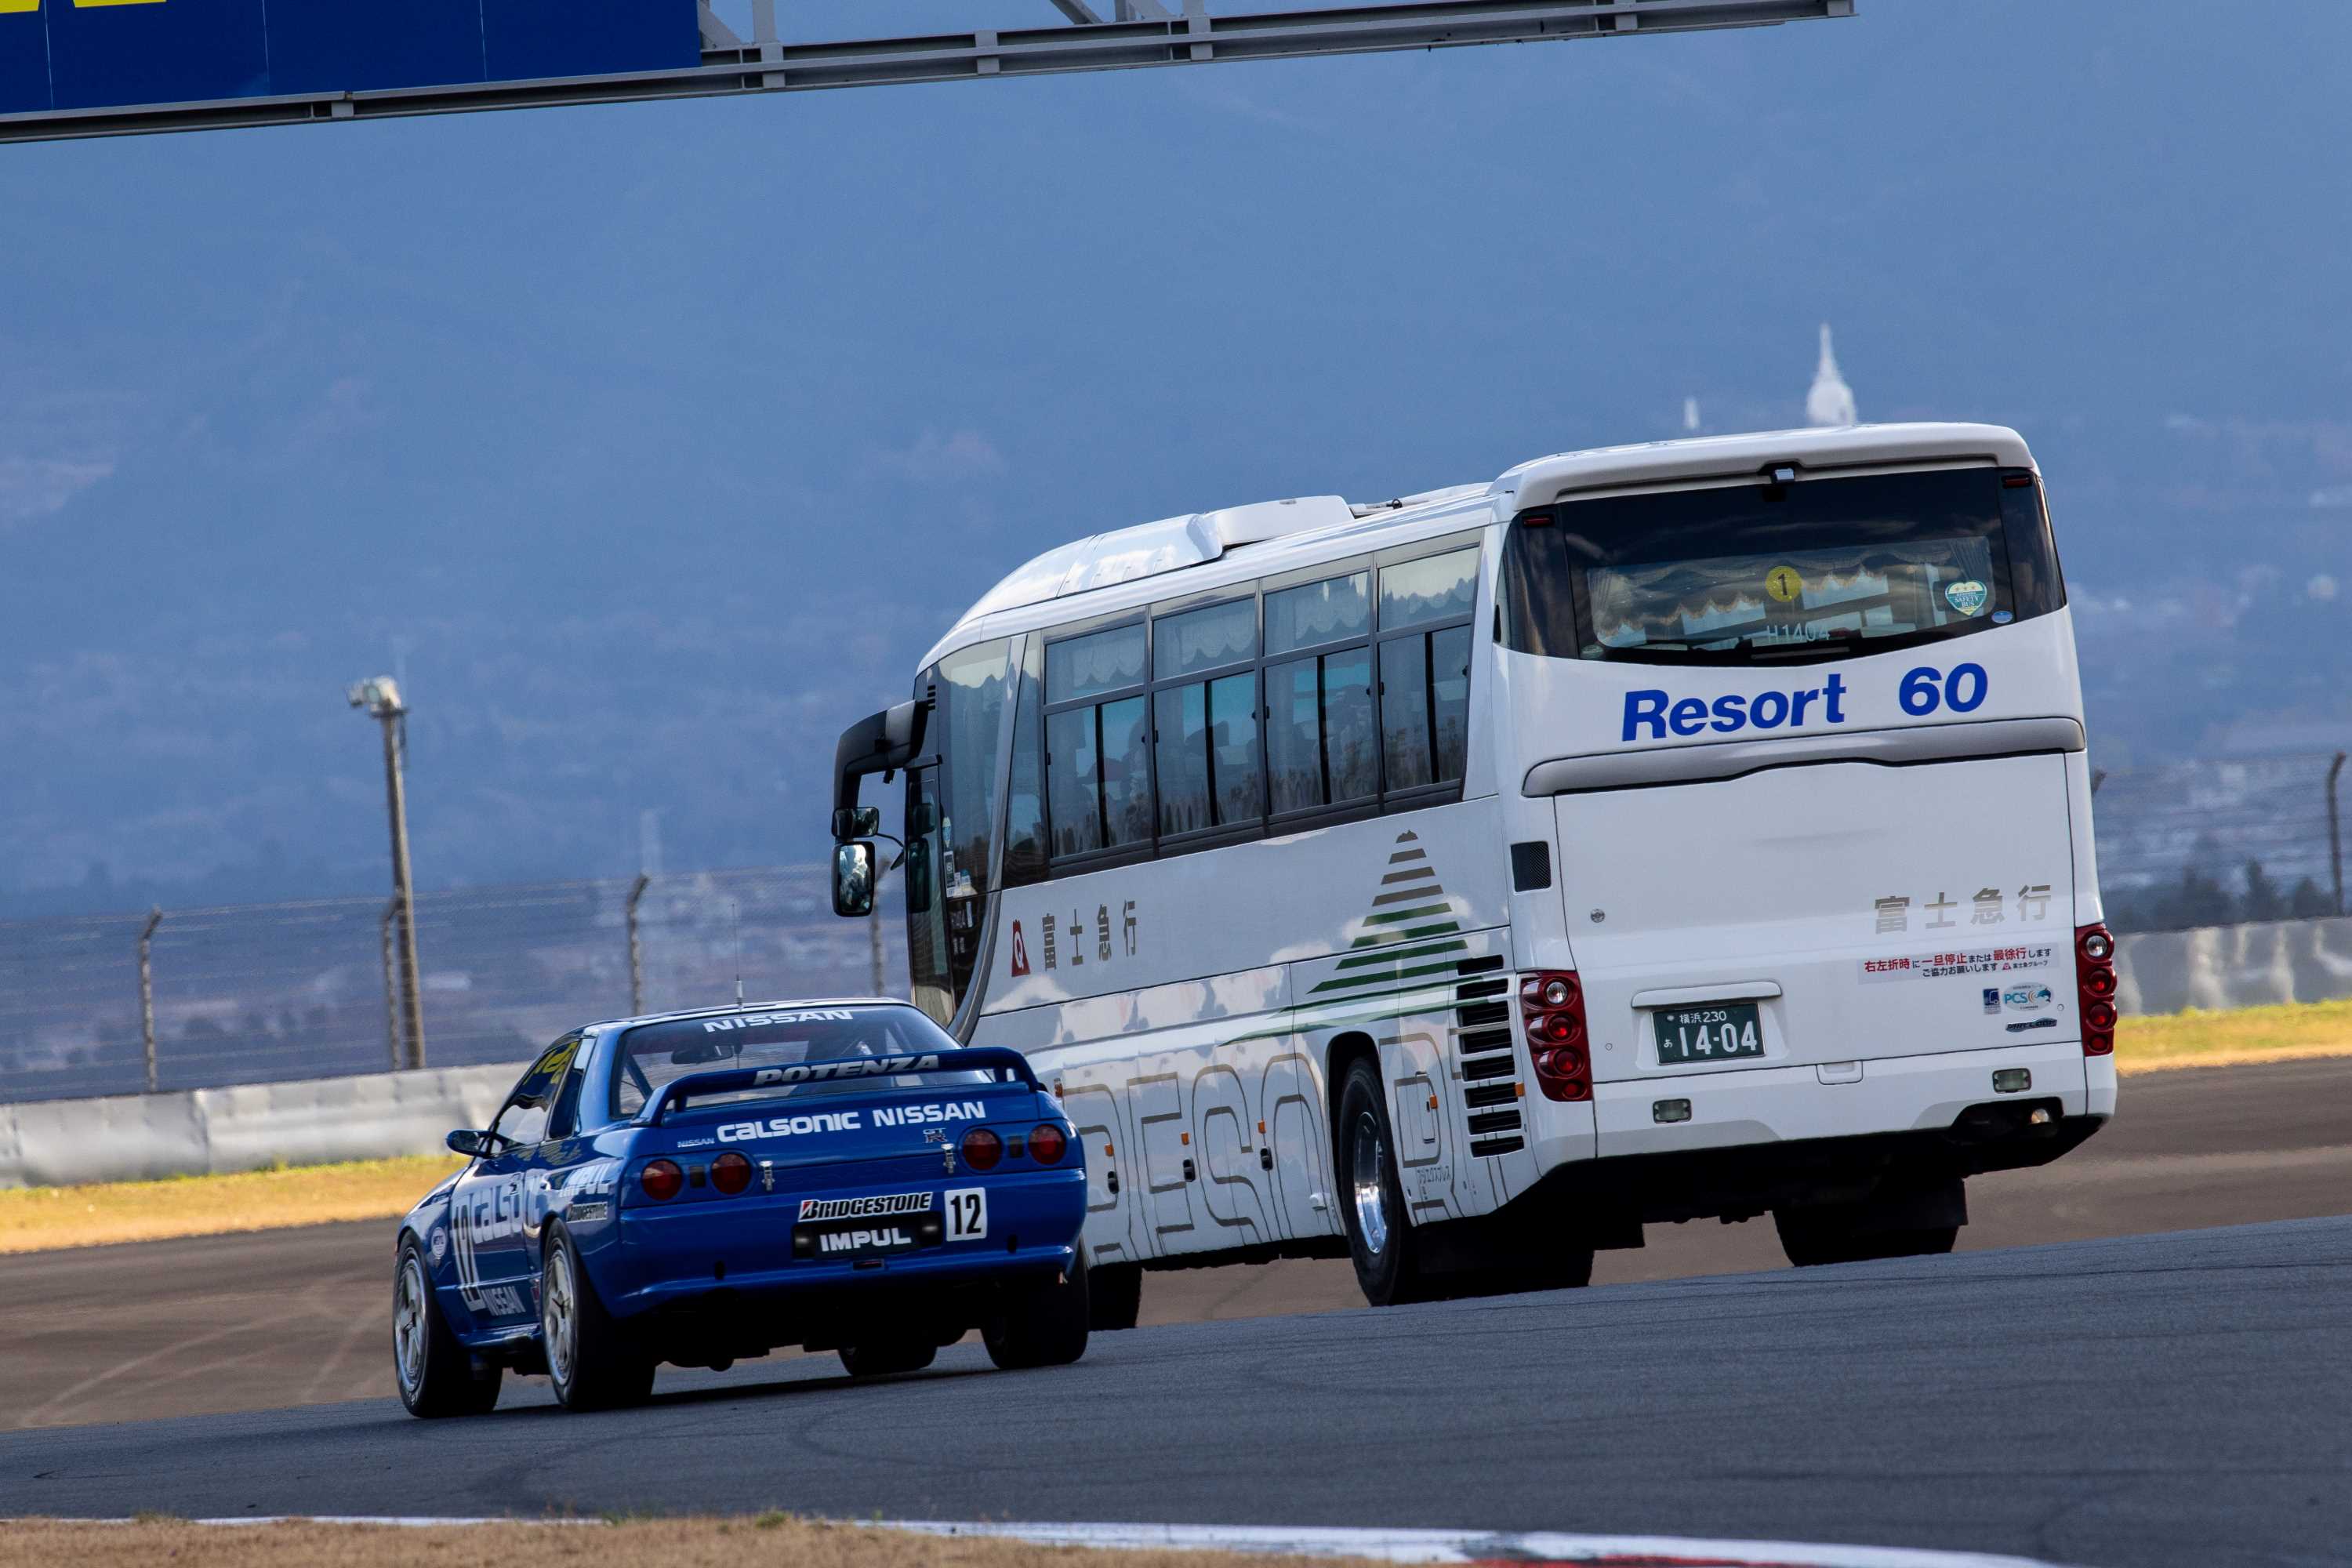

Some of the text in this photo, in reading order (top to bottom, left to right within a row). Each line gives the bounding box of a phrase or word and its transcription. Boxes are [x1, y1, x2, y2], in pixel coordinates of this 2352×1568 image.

[1777, 573, 1788, 596] 1
[1622, 662, 1988, 742] Resort 60
[1875, 884, 2052, 935] 富士急行
[1042, 899, 1136, 972] 富士急行
[2004, 992, 2028, 1004] PCS
[703, 1010, 853, 1033] NISSAN
[753, 1054, 939, 1086] POTENZA
[872, 1101, 985, 1127] NISSAN
[677, 1138, 715, 1148] NISSAN
[800, 1192, 932, 1220] BRIDGESTONE
[950, 1193, 982, 1236] 12
[820, 1228, 911, 1252] IMPUL
